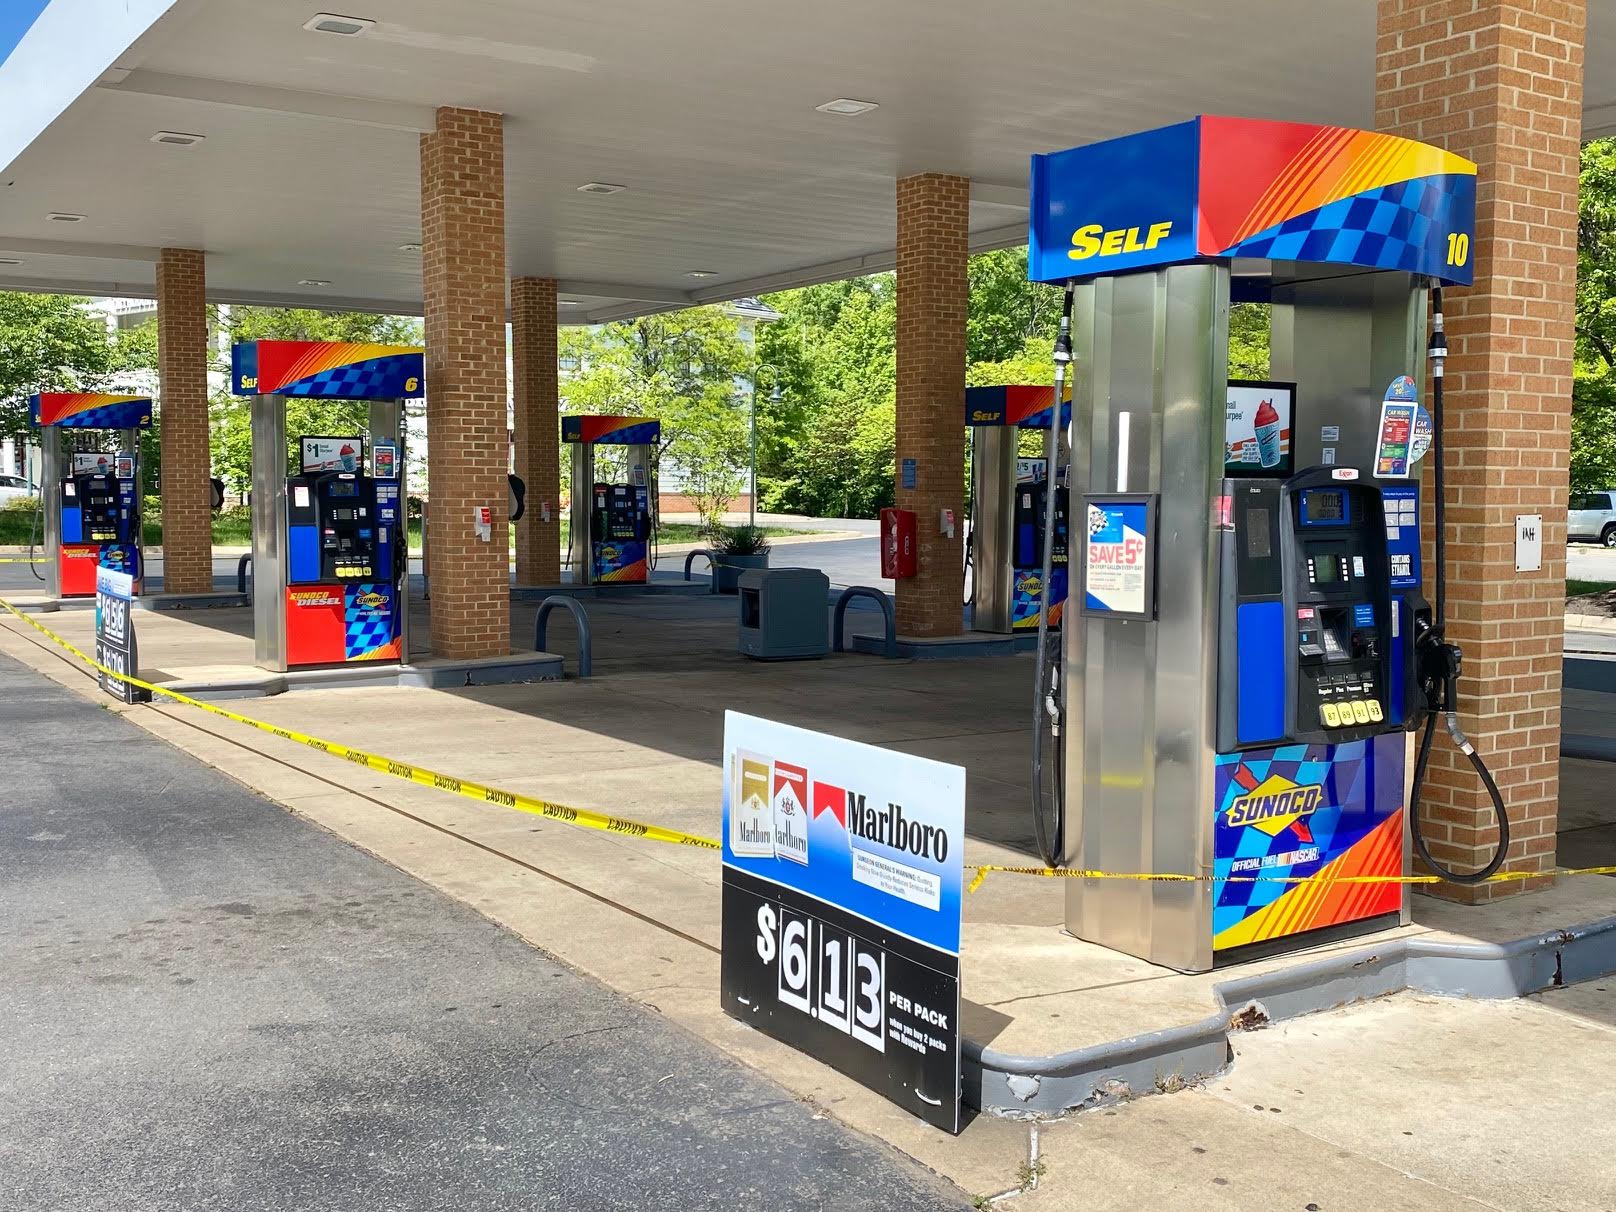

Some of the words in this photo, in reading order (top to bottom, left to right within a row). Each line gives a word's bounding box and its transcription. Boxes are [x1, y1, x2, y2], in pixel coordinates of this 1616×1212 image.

[1068, 221, 1172, 260] SELF
[1447, 232, 1469, 267] 10
[241, 374, 258, 389] SELF
[405, 377, 418, 392] 6
[139, 415, 150, 425] 2
[972, 410, 1000, 421] SELF
[307, 443, 319, 458] $1
[1089, 545, 1124, 564] SAVE
[1125, 539, 1143, 564] 5¢
[289, 592, 329, 600] SUNOCO
[1019, 583, 1043, 591] SUNOC
[297, 598, 341, 606] DIESEL
[357, 596, 388, 604] SUNOCO
[1327, 712, 1336, 721] 87
[1342, 710, 1351, 719] 89
[1356, 709, 1365, 717] 91
[1370, 707, 1380, 715] 93
[345, 749, 369, 766] CAUTION
[387, 762, 413, 779] CAUTION
[433, 774, 461, 792] CAUTION
[485, 788, 516, 807] CAUTION
[542, 802, 577, 821] CAUTION
[1231, 788, 1321, 824] SUNOCO
[740, 817, 771, 844] Marlboro
[775, 819, 807, 853] arlboro
[848, 790, 949, 864] Marlboro
[857, 854, 875, 867] SURGEON
[1231, 857, 1260, 872] OFFICIAL
[1261, 855, 1277, 868] FUEL
[757, 903, 881, 1029] $6.13
[889, 991, 912, 1014] PER
[914, 1003, 948, 1030] PACK
[900, 1033, 927, 1055] Rewards
[913, 1028, 923, 1043] buy
[923, 1033, 929, 1044] 2
[928, 1037, 947, 1052] packs
